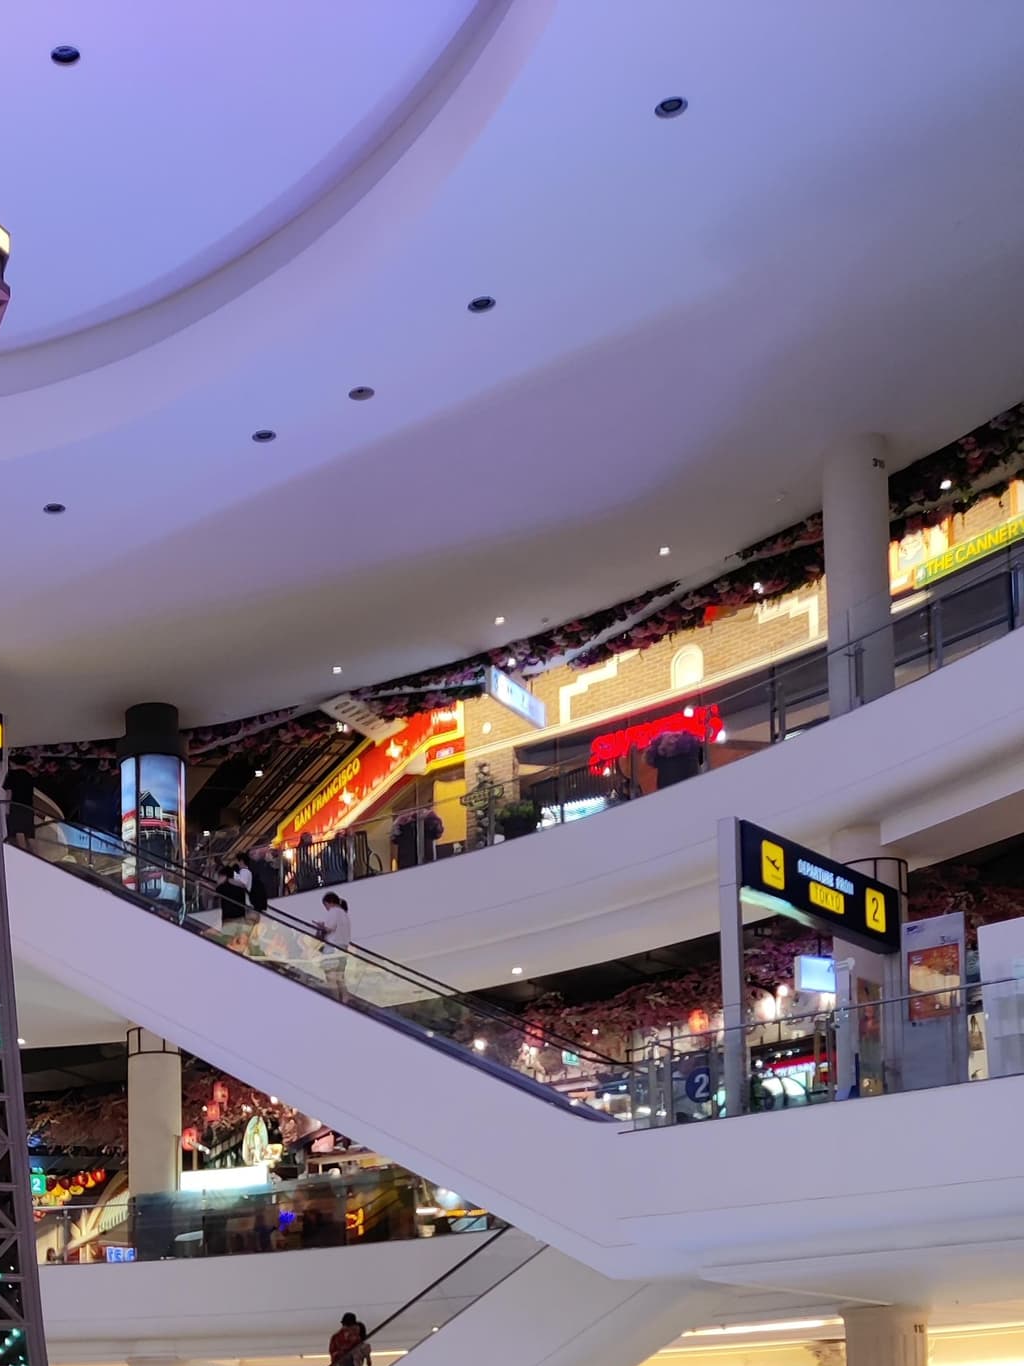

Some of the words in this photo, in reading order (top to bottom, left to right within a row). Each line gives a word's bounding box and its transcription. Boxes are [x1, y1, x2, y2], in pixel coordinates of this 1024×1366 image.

[926, 553, 954, 577] THE
[310, 757, 361, 816] FRANCISCO
[797, 858, 834, 888] DEPARTURE
[814, 884, 841, 912] TOKYO
[871, 896, 880, 923] 2
[694, 1073, 710, 1099] 2
